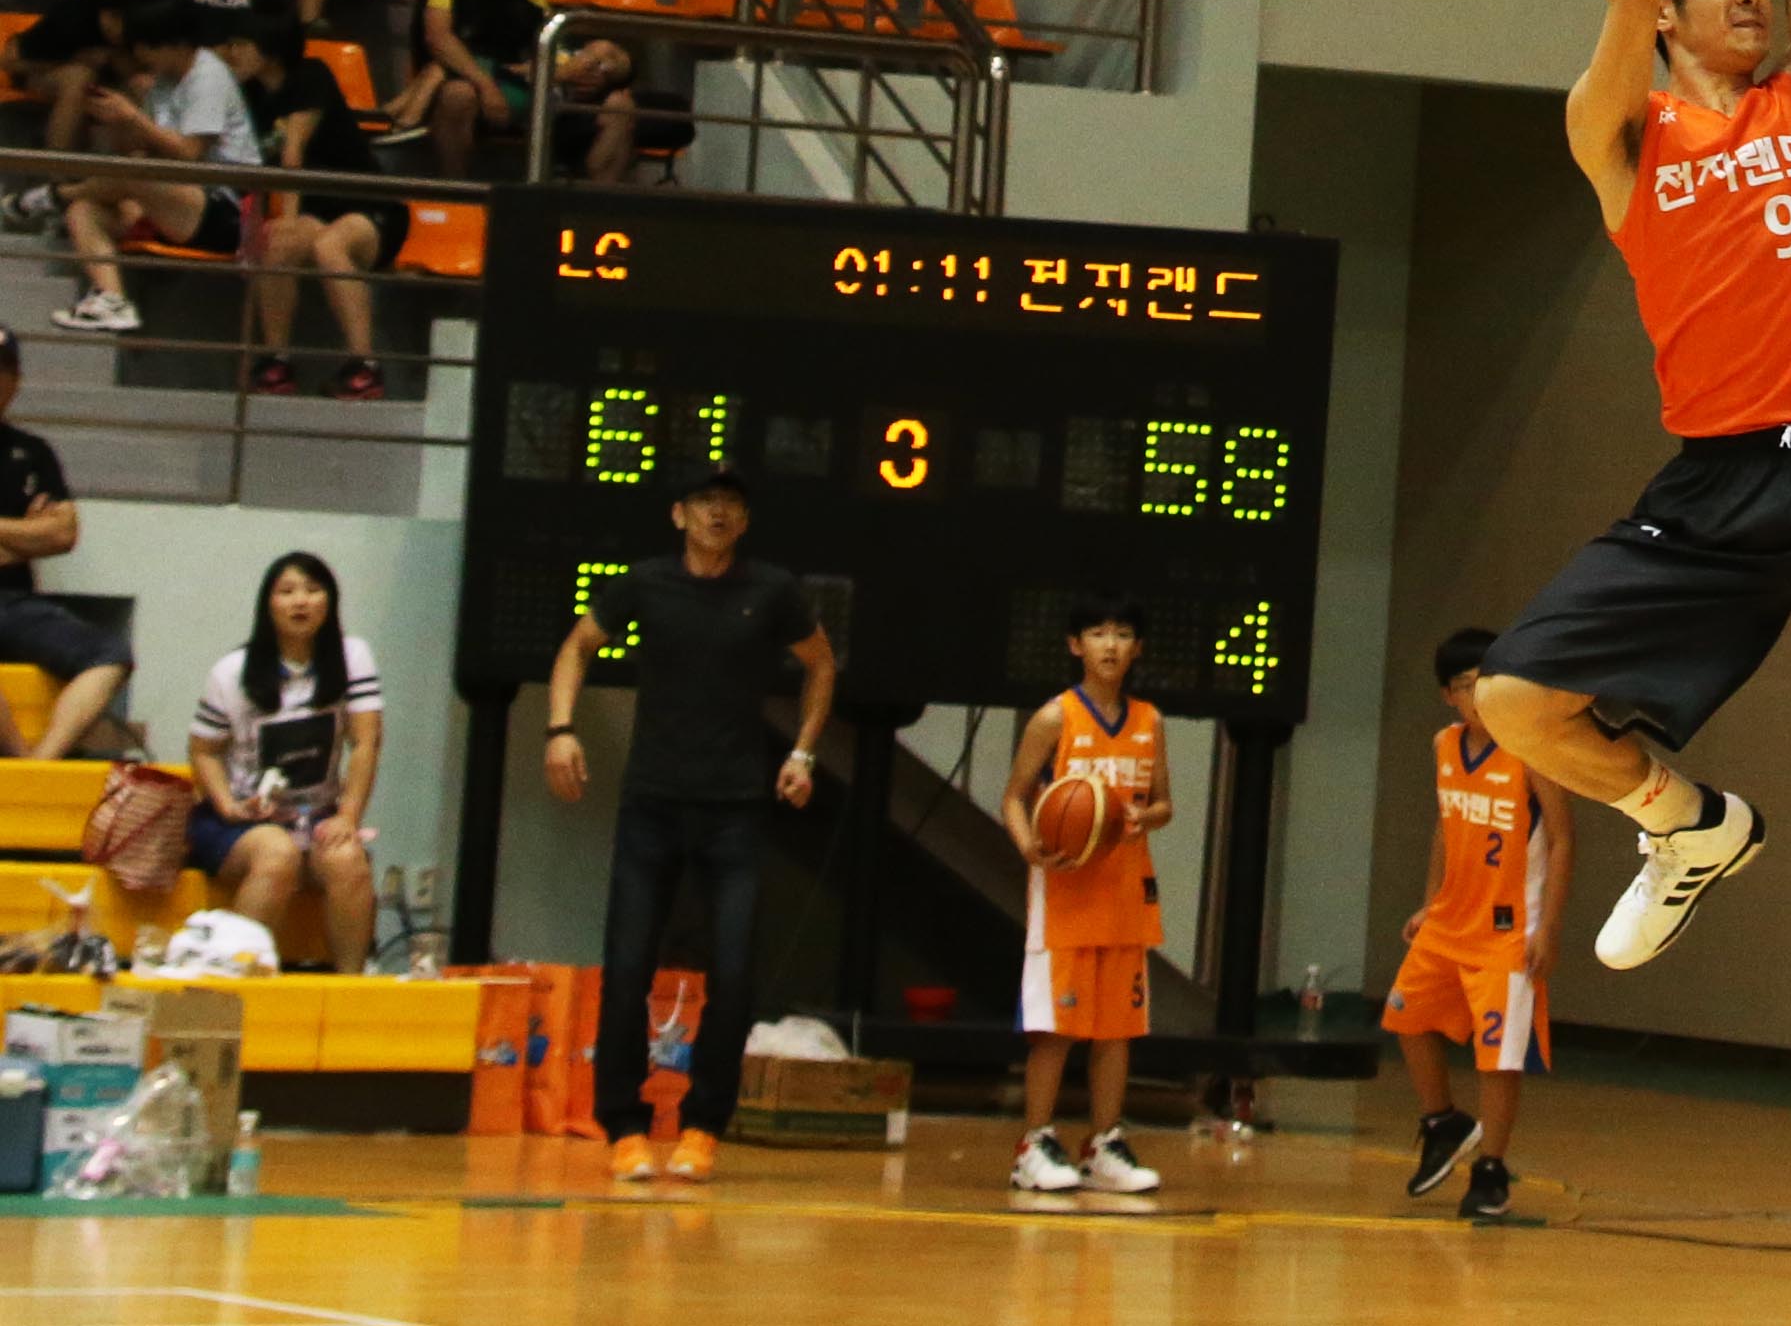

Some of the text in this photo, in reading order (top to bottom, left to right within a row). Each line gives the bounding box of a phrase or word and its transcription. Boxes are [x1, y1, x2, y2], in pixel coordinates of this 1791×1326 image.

[554, 225, 633, 282] LG
[833, 245, 993, 305] 01:11
[585, 387, 728, 486] 61
[1141, 420, 1291, 523] 58
[1214, 600, 1280, 695] 4
[1484, 831, 1505, 867] 2
[1481, 1010, 1503, 1047] 2
